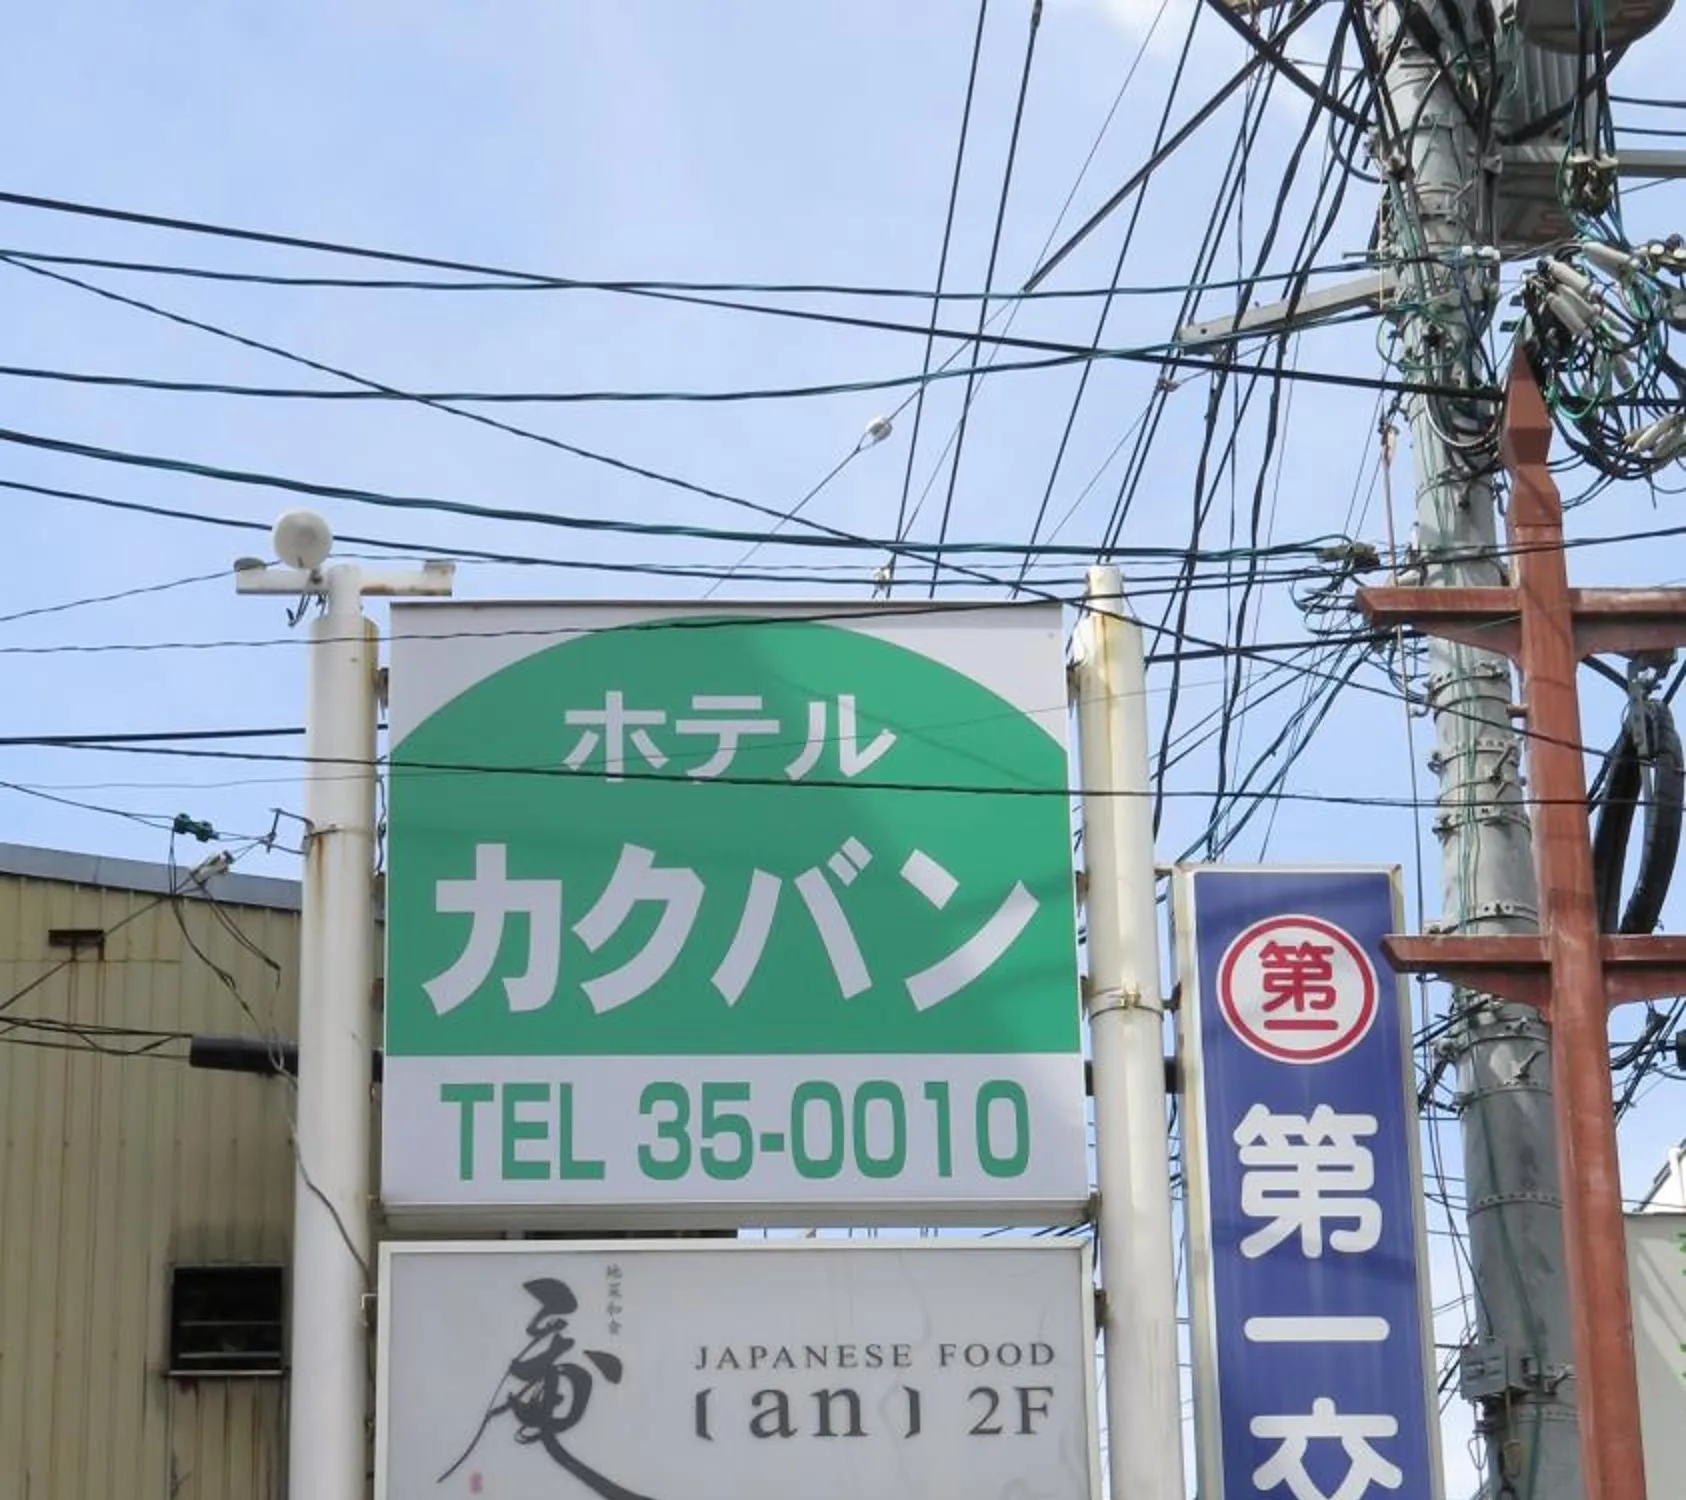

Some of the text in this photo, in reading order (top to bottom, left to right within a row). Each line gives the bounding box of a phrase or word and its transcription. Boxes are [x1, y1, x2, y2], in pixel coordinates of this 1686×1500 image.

[564, 690, 897, 784] ホテル
[422, 836, 1041, 1017] カクバン
[1257, 938, 1340, 1032] 第一
[440, 1080, 1031, 1181] TEL 35-0010
[695, 1341, 1056, 1371] JAPANESE FOOD
[968, 1386, 1056, 1438] 2F
